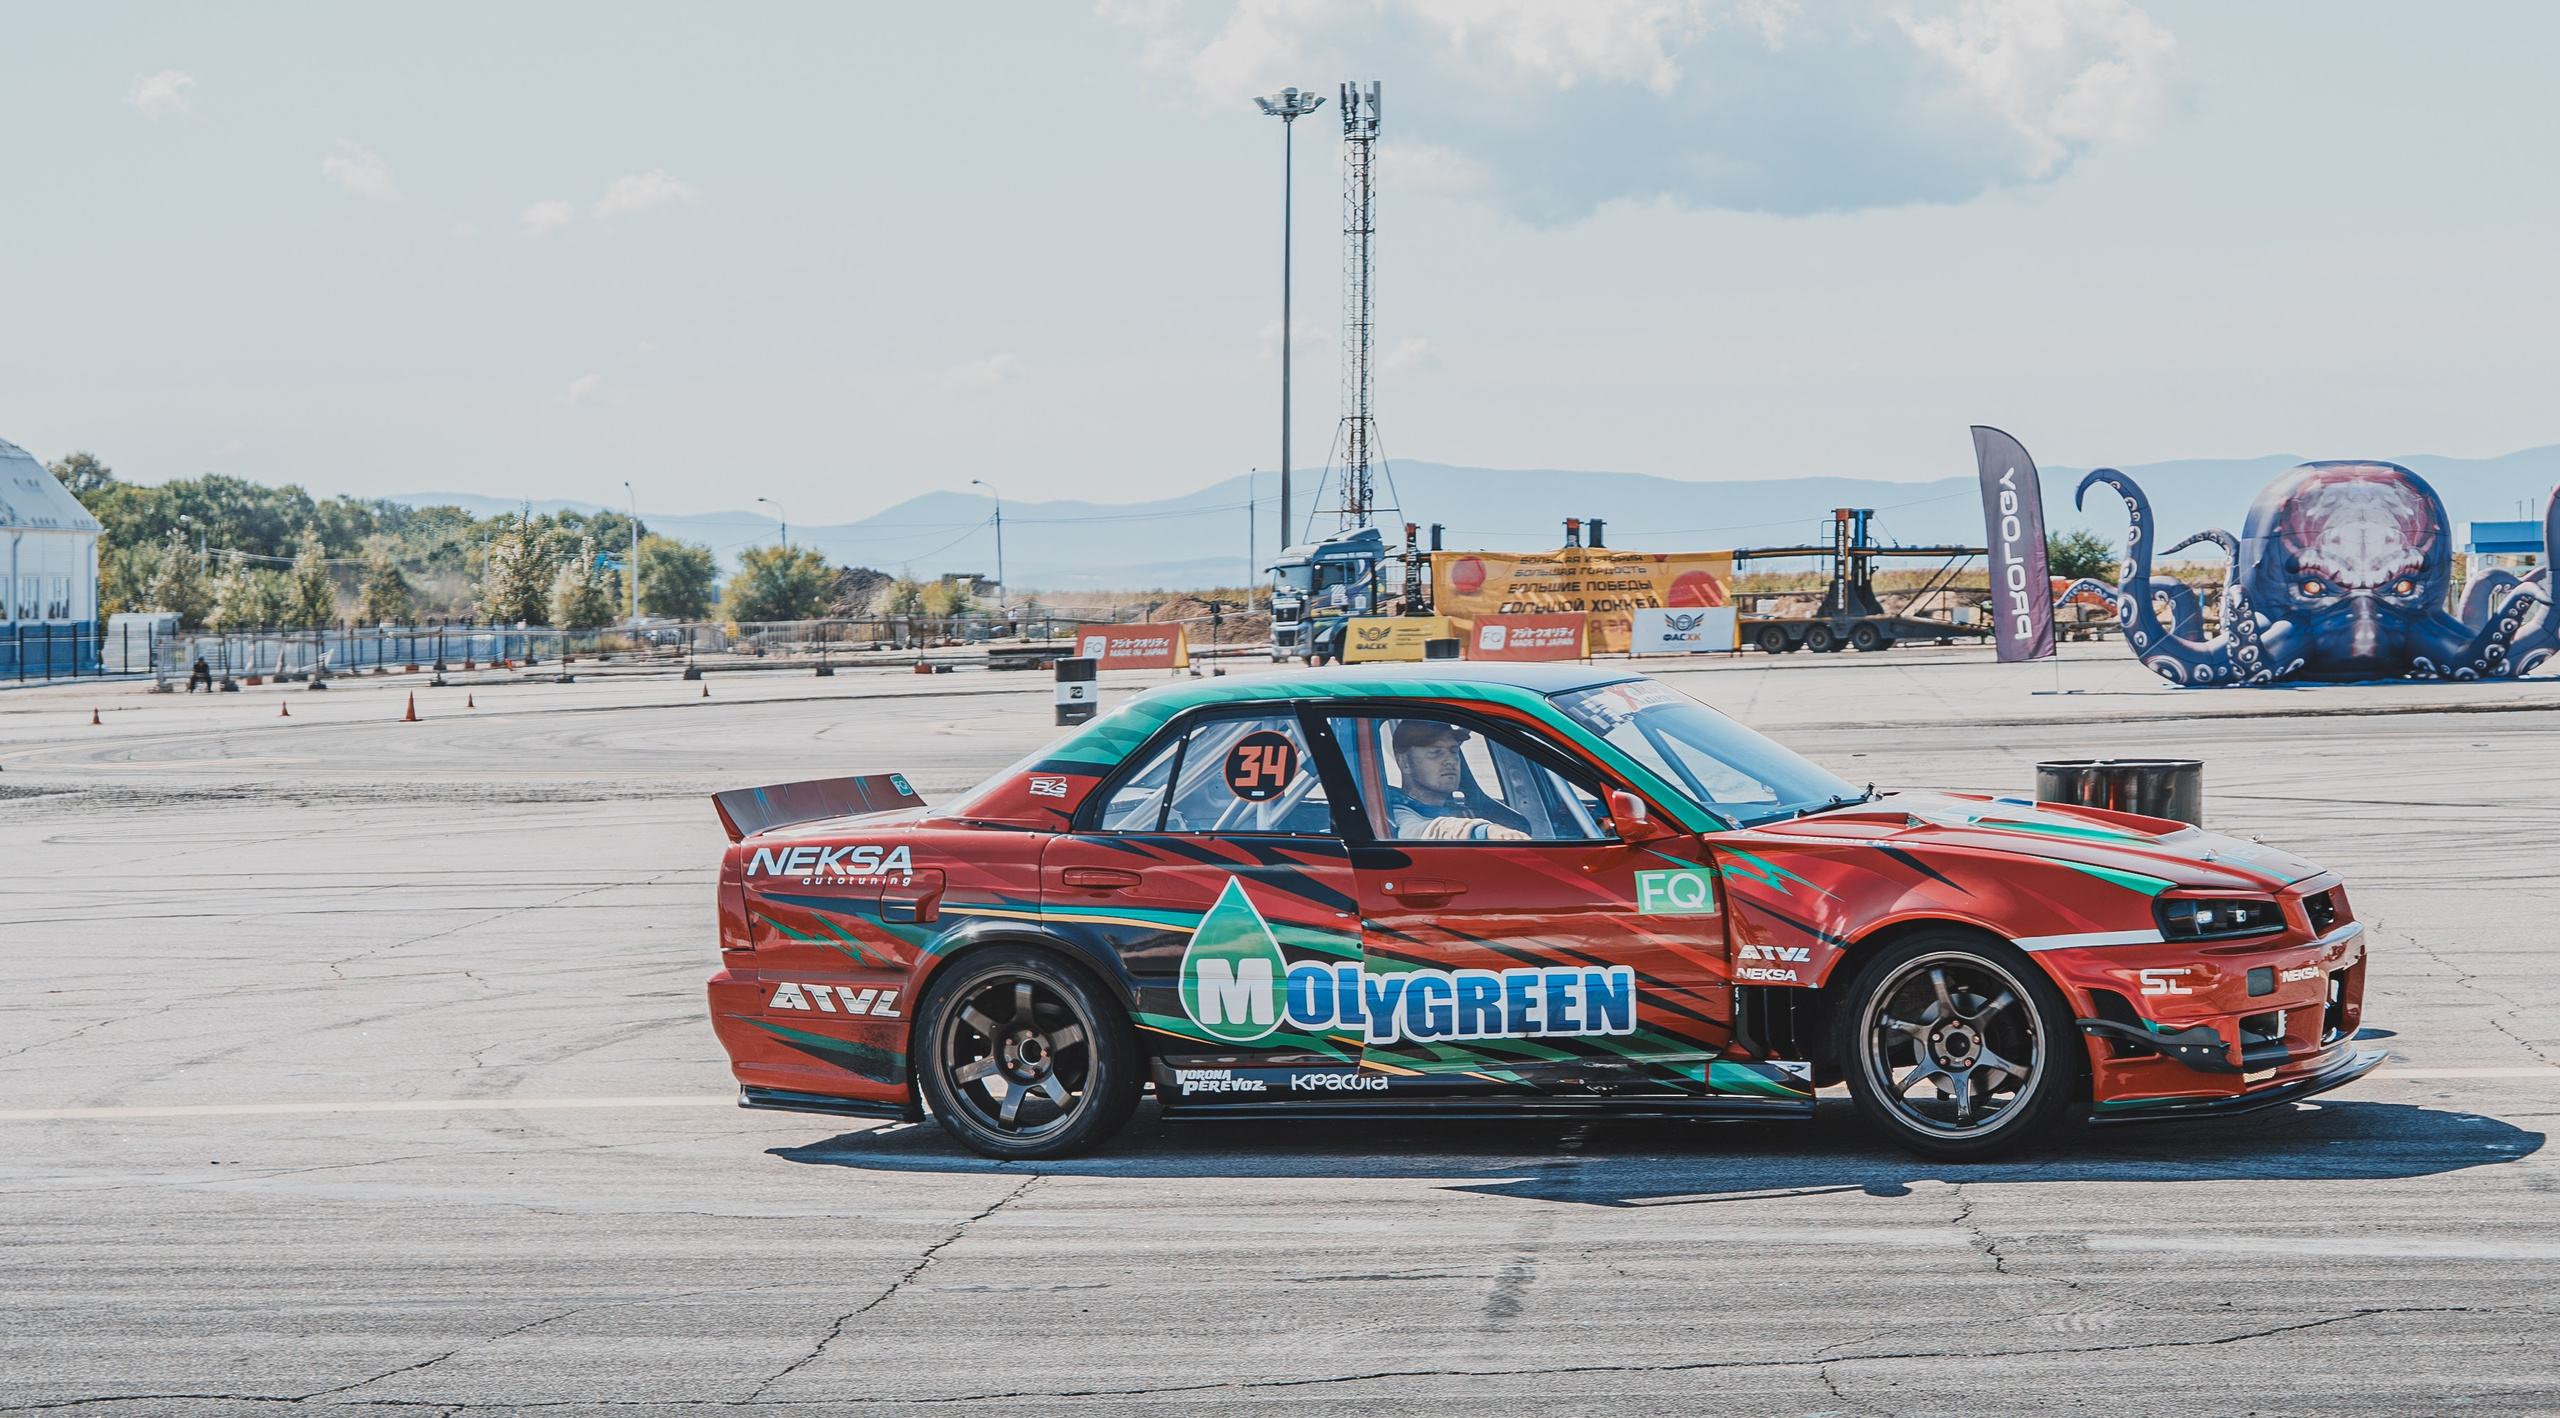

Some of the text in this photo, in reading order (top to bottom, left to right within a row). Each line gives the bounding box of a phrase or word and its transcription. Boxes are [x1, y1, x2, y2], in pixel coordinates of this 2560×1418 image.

[1514, 566, 1647, 577] БОЛЬШАЯ ГОРДОСТЬ
[1507, 580, 1653, 594] БОЛЬШИЕ ПОБЕДЫ
[1510, 639, 1534, 647] MADE
[1547, 638, 1574, 646] JAPAN
[1109, 647, 1169, 657] MADE IN JAPAN
[1235, 746, 1288, 787] 34
[746, 846, 914, 876] NEKSA
[802, 877, 912, 886] autotuning
[1641, 873, 1706, 910] FQ
[1738, 945, 1811, 962] ATVL
[1736, 968, 1798, 982] NEKSA
[2282, 966, 2320, 982] NEKSA
[769, 982, 901, 1017] ATVL
